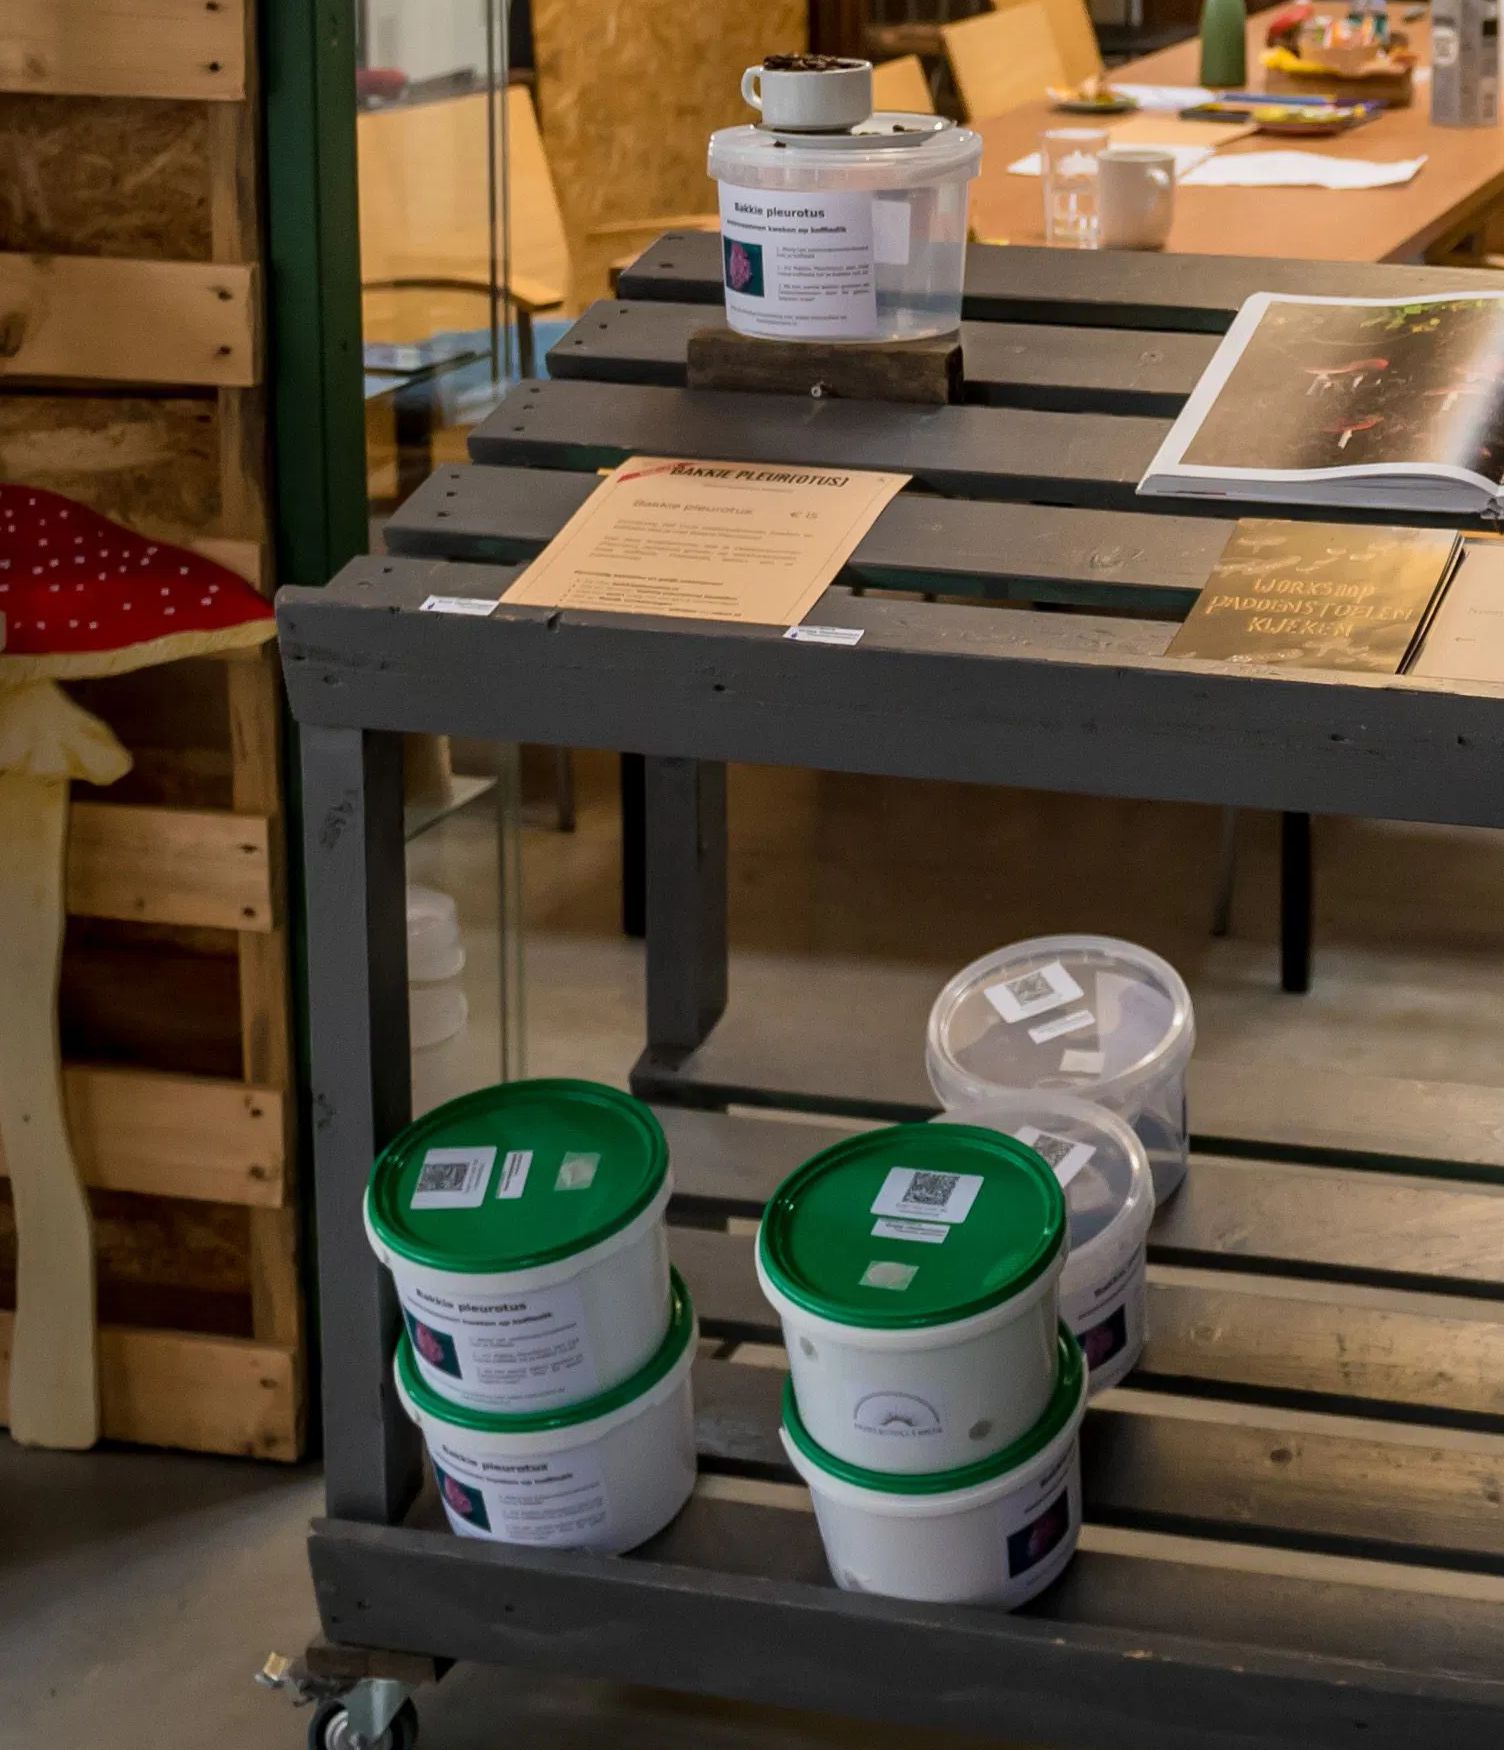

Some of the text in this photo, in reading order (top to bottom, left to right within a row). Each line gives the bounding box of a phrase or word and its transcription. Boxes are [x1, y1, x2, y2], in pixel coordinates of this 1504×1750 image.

[734, 202, 825, 218] Bakkie pleurotus
[670, 465, 734, 480] BAKKIE
